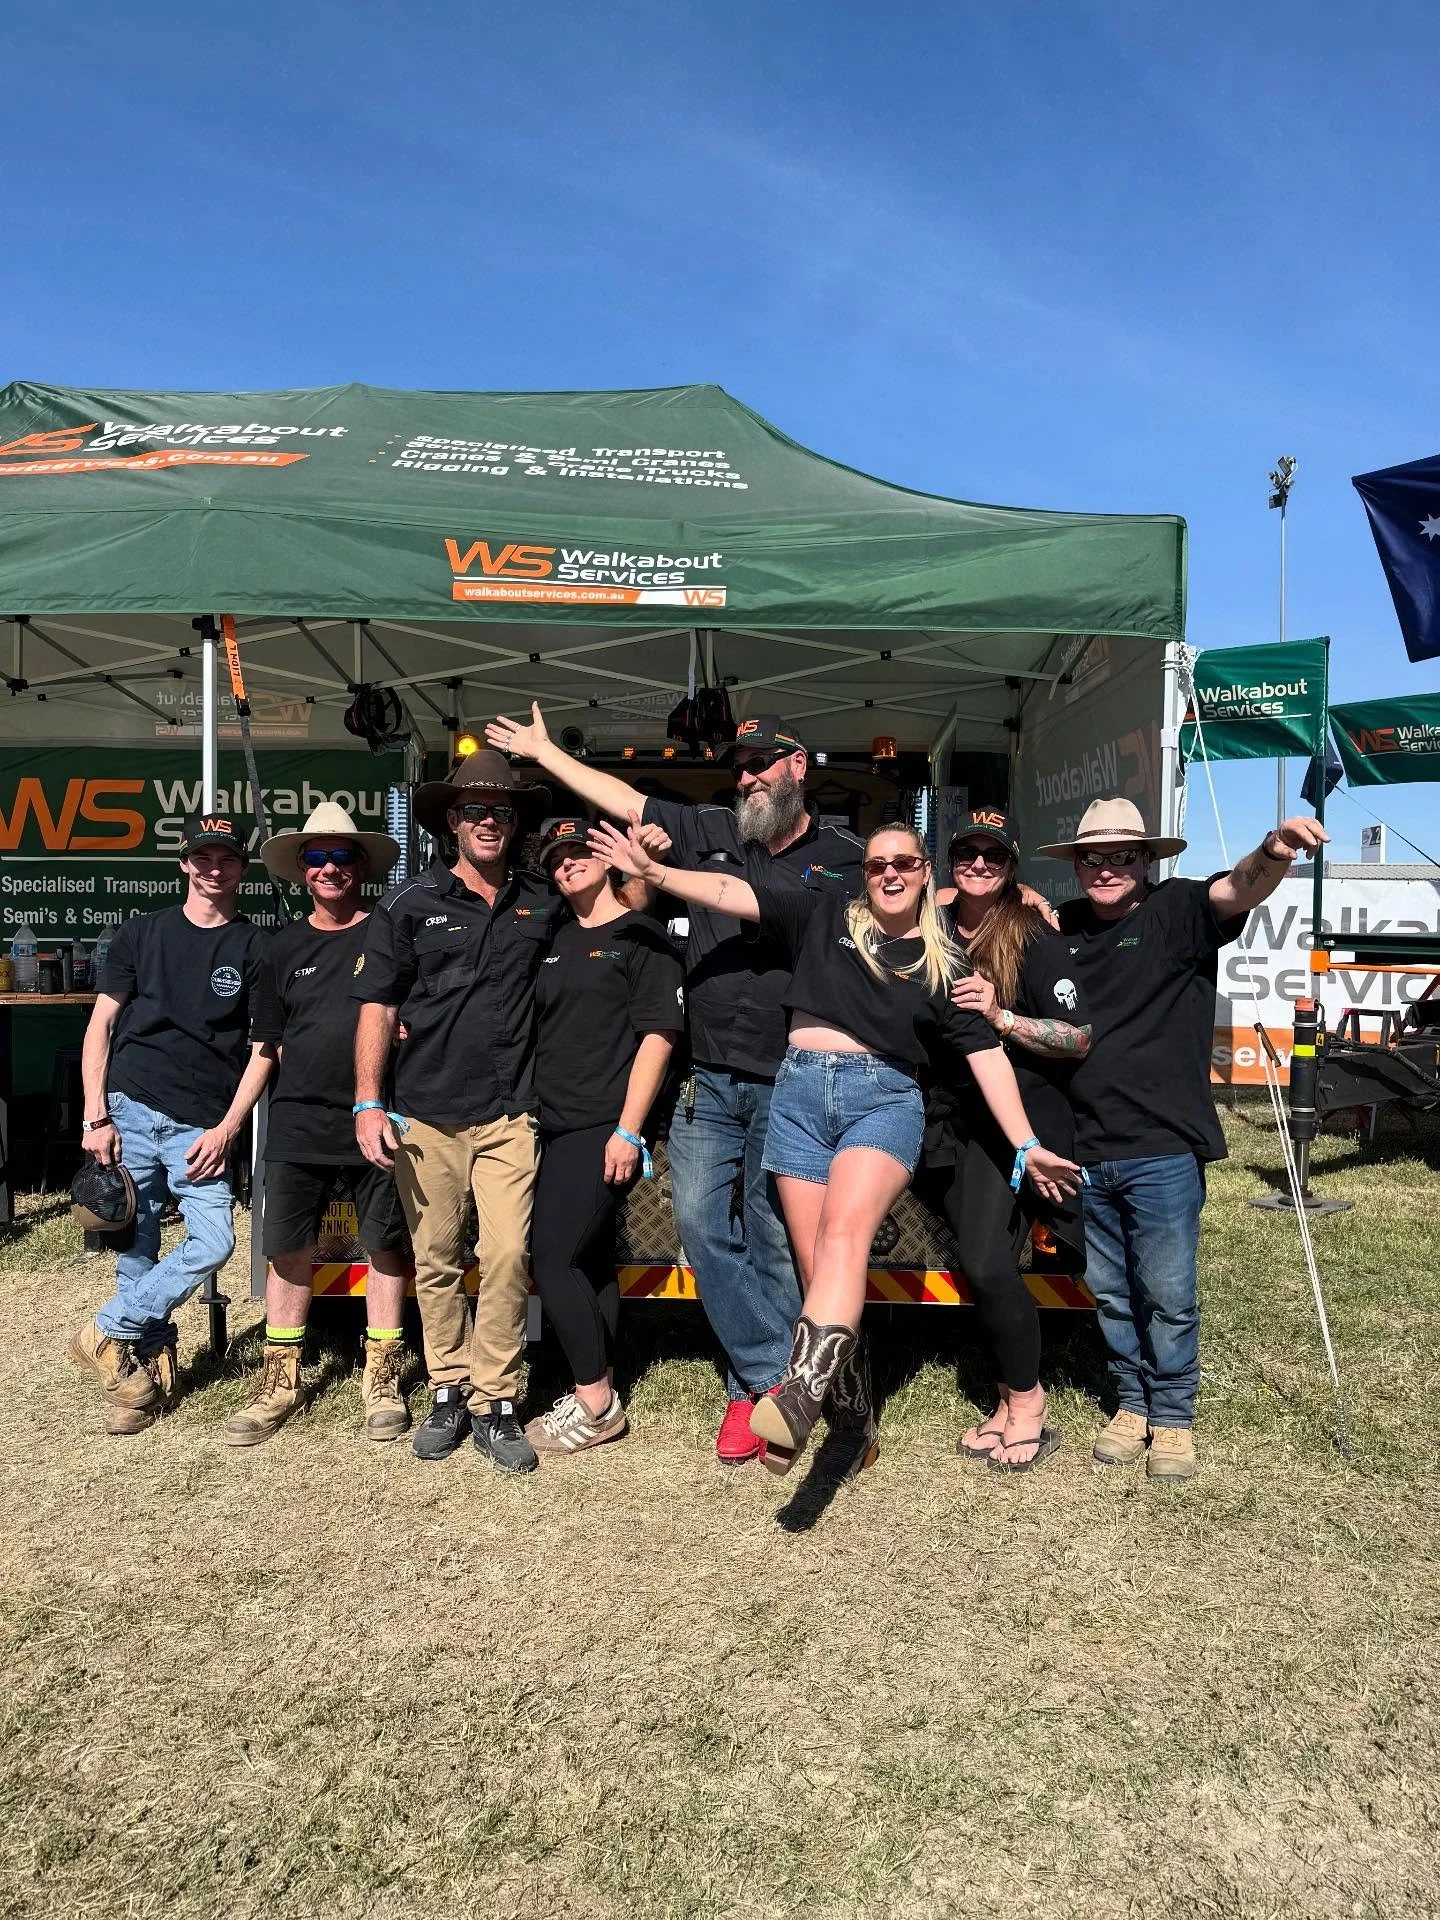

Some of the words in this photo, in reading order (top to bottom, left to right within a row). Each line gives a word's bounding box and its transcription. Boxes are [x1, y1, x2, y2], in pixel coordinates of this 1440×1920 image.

[104, 422, 349, 437] Walkabout
[83, 431, 281, 451] Services
[414, 435, 576, 456] Specialised
[592, 448, 725, 459] Transport
[400, 449, 502, 462] Cranes
[547, 461, 632, 472] Crane
[644, 467, 741, 480] Trucks
[547, 454, 619, 466] Semi
[631, 458, 730, 469] Cranes
[391, 459, 510, 475] Rigging
[524, 465, 548, 476] &
[559, 467, 749, 490] Installations
[444, 538, 556, 577] WS
[560, 548, 723, 569] Walkabout
[557, 563, 685, 585] Services
[464, 587, 625, 600] walkaboutservices.com.au
[683, 589, 725, 605] WS
[1198, 678, 1308, 704] Walkabout
[1202, 700, 1285, 718] Services
[153, 779, 388, 815] Walkabou
[0, 778, 146, 850] WS
[972, 811, 1006, 828] WS
[200, 819, 232, 833] WS
[1, 875, 95, 895] Specialised
[104, 876, 181, 896] Transport
[289, 881, 301, 896] &
[65, 908, 77, 924] &
[83, 908, 123, 925] Semi
[425, 915, 448, 927] CREW
[294, 966, 317, 978] STAFF
[1225, 955, 1440, 1005] Servic
[320, 1220, 350, 1235] RNING
